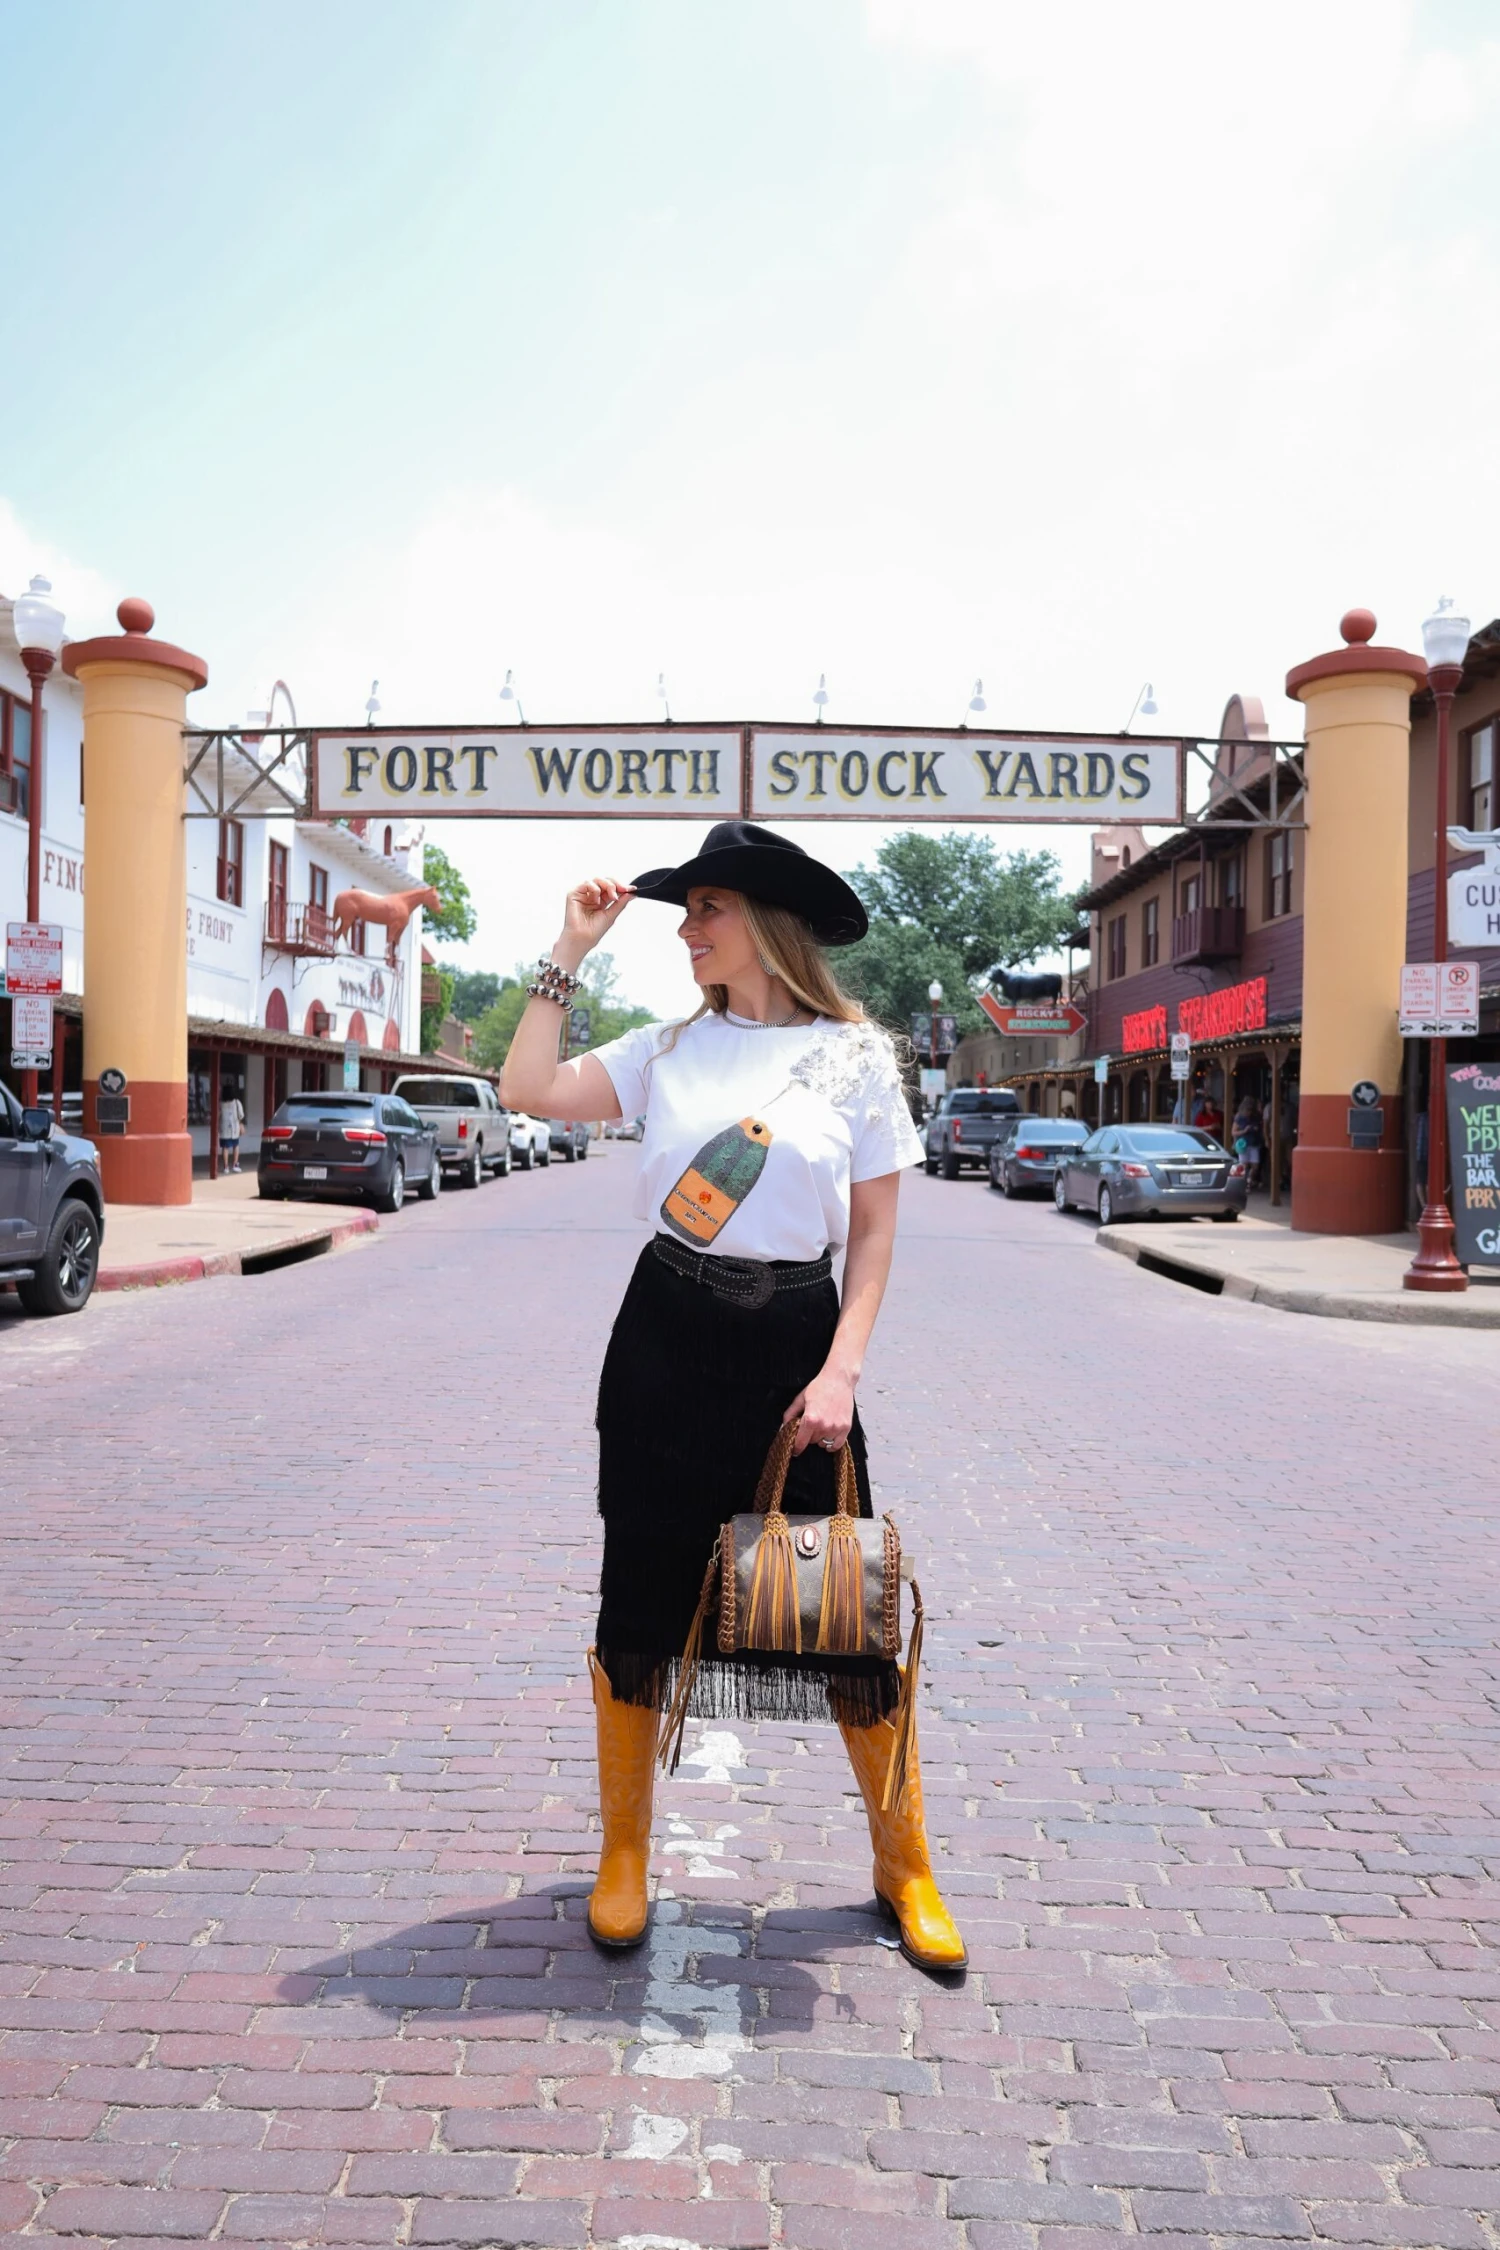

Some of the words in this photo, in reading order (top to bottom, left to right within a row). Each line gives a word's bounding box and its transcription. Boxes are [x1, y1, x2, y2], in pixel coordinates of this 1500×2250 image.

[342, 746, 498, 797] FORT
[527, 747, 721, 797] WORTH
[769, 750, 946, 801] STOCK
[974, 751, 1151, 803] YARDS
[1466, 884, 1500, 907] CU
[198, 912, 234, 944] FRONT
[1412, 968, 1426, 976] NO
[26, 1000, 40, 1008] NO
[1016, 1008, 1063, 1018] RISCKY'S
[1178, 976, 1267, 1041] STEAKHOUSE
[17, 1015, 49, 1023] STOPPING
[17, 1031, 49, 1039] STANDING
[1450, 1064, 1482, 1082] THE
[1467, 1126, 1500, 1152] PB
[1462, 1153, 1494, 1169] THE
[1466, 1168, 1500, 1188] BAR
